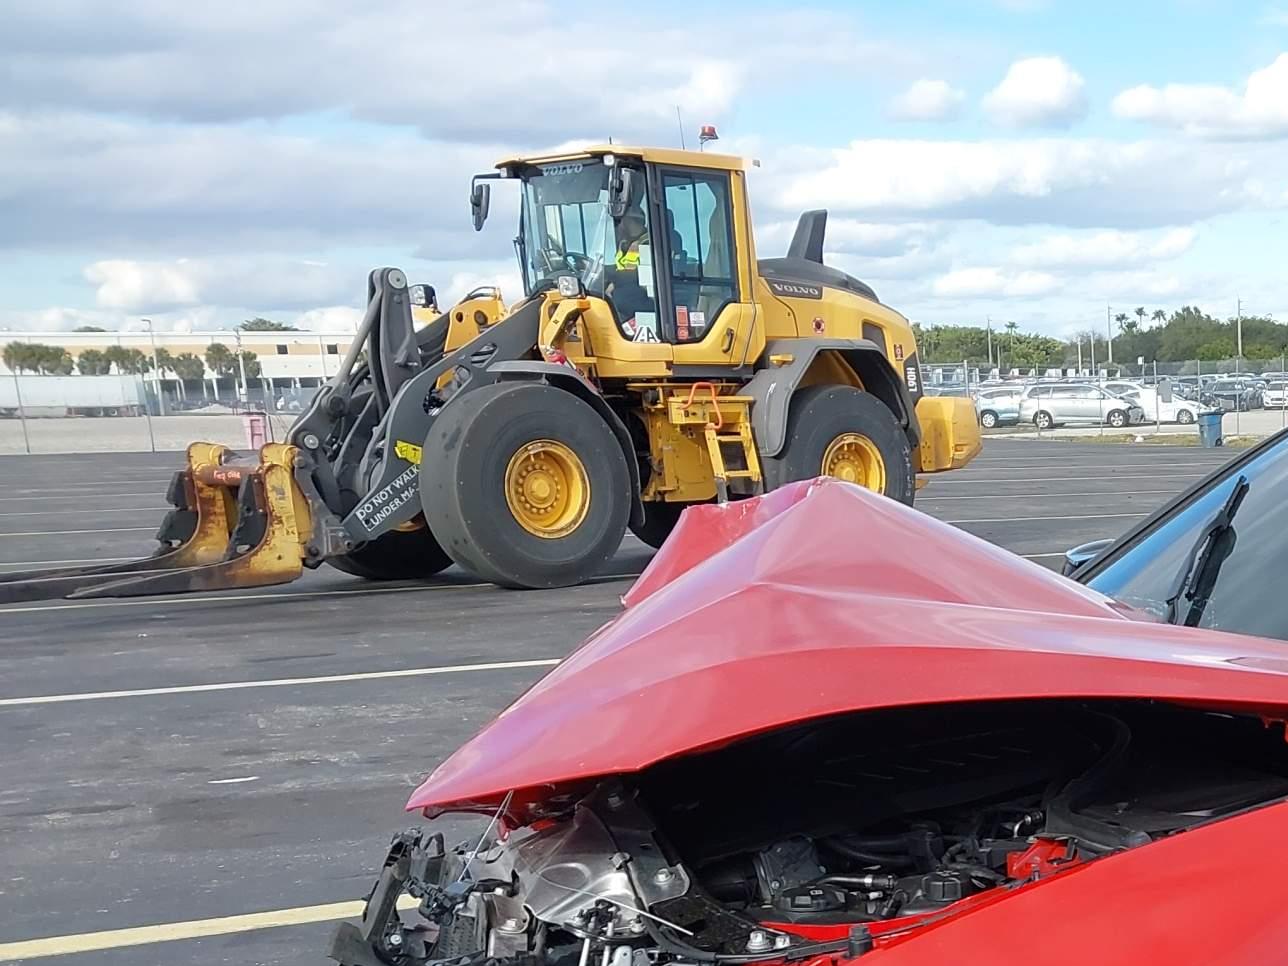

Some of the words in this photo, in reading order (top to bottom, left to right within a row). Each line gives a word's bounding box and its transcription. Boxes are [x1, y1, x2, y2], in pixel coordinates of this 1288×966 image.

[543, 164, 583, 176] VOLVO
[773, 283, 819, 295] VOLVO
[906, 367, 917, 392] L90H
[355, 502, 374, 520] DO
[372, 485, 394, 507] NOT
[392, 464, 420, 489] WALK
[369, 497, 404, 525] UNDER
